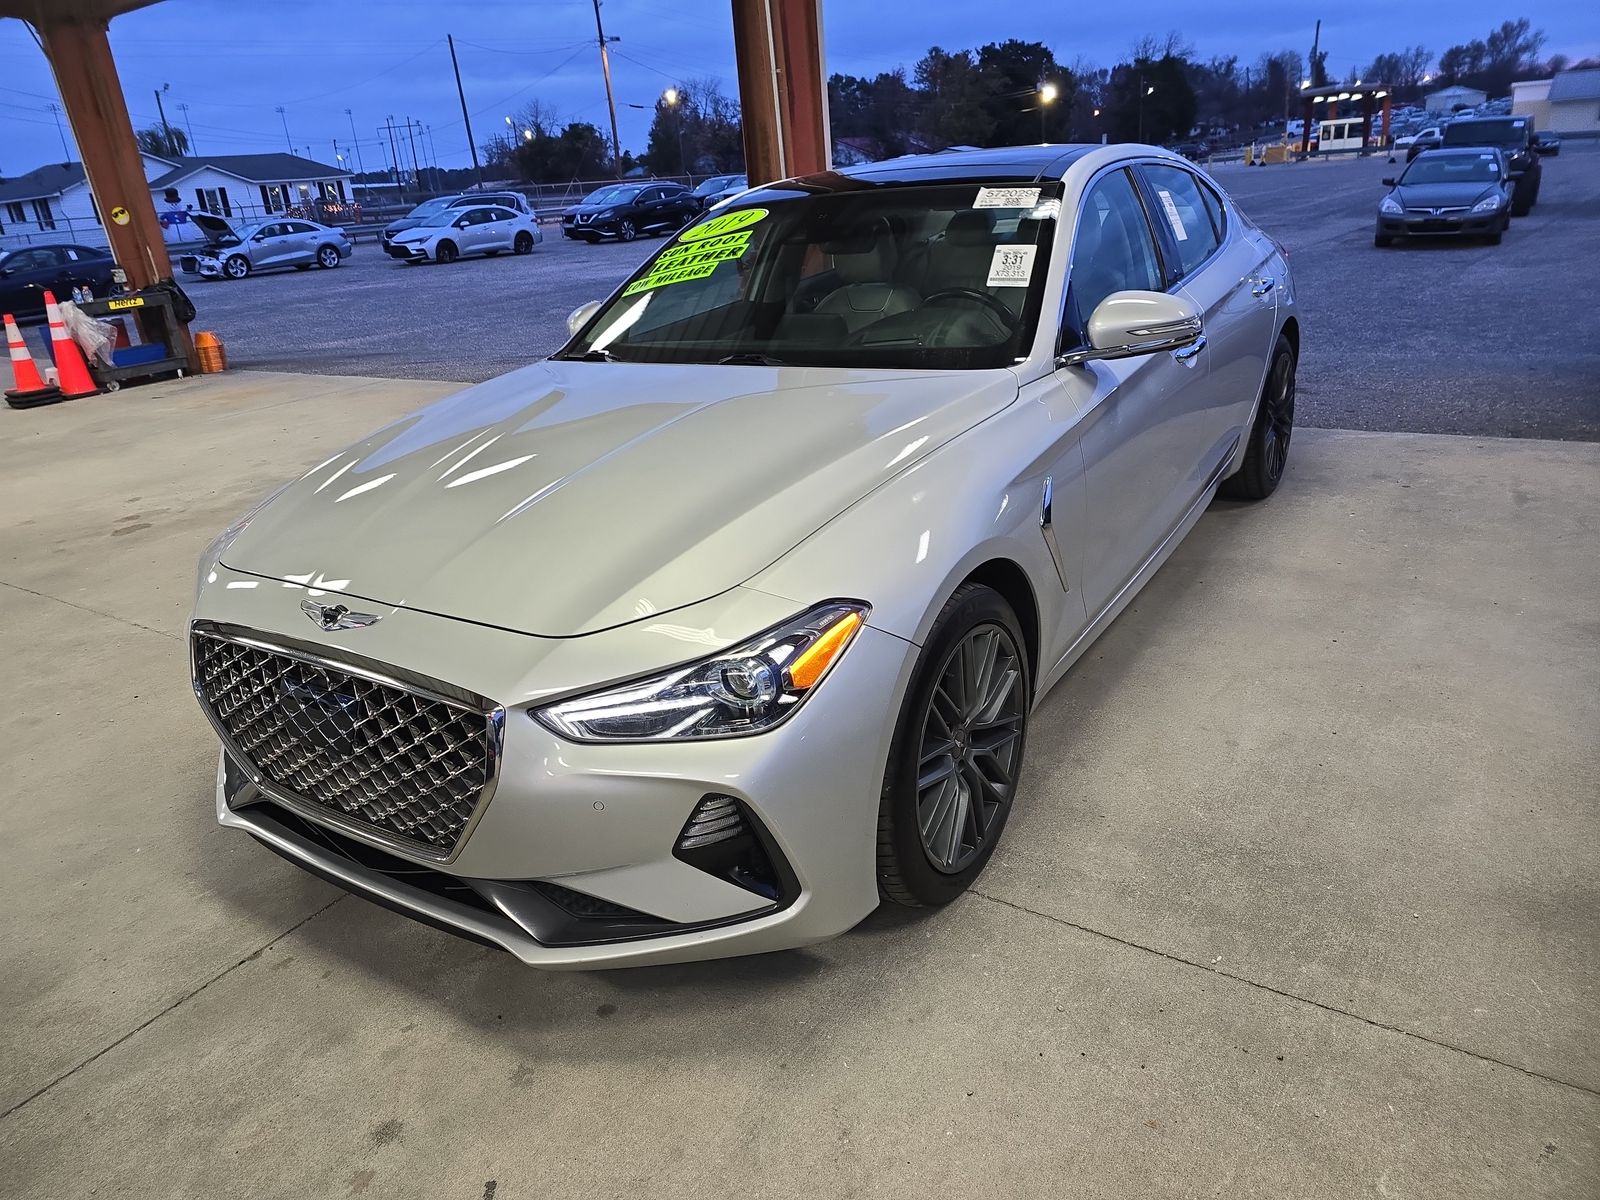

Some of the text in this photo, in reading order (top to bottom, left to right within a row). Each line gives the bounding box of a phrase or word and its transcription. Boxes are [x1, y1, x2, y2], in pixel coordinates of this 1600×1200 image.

[691, 212, 755, 238] 2019
[654, 246, 743, 273] LEATHER
[659, 233, 750, 260] SUN ROOF
[1002, 255, 1024, 265] 3:31
[626, 265, 712, 293] LOW MILEAGE
[115, 298, 137, 307] Hertz
